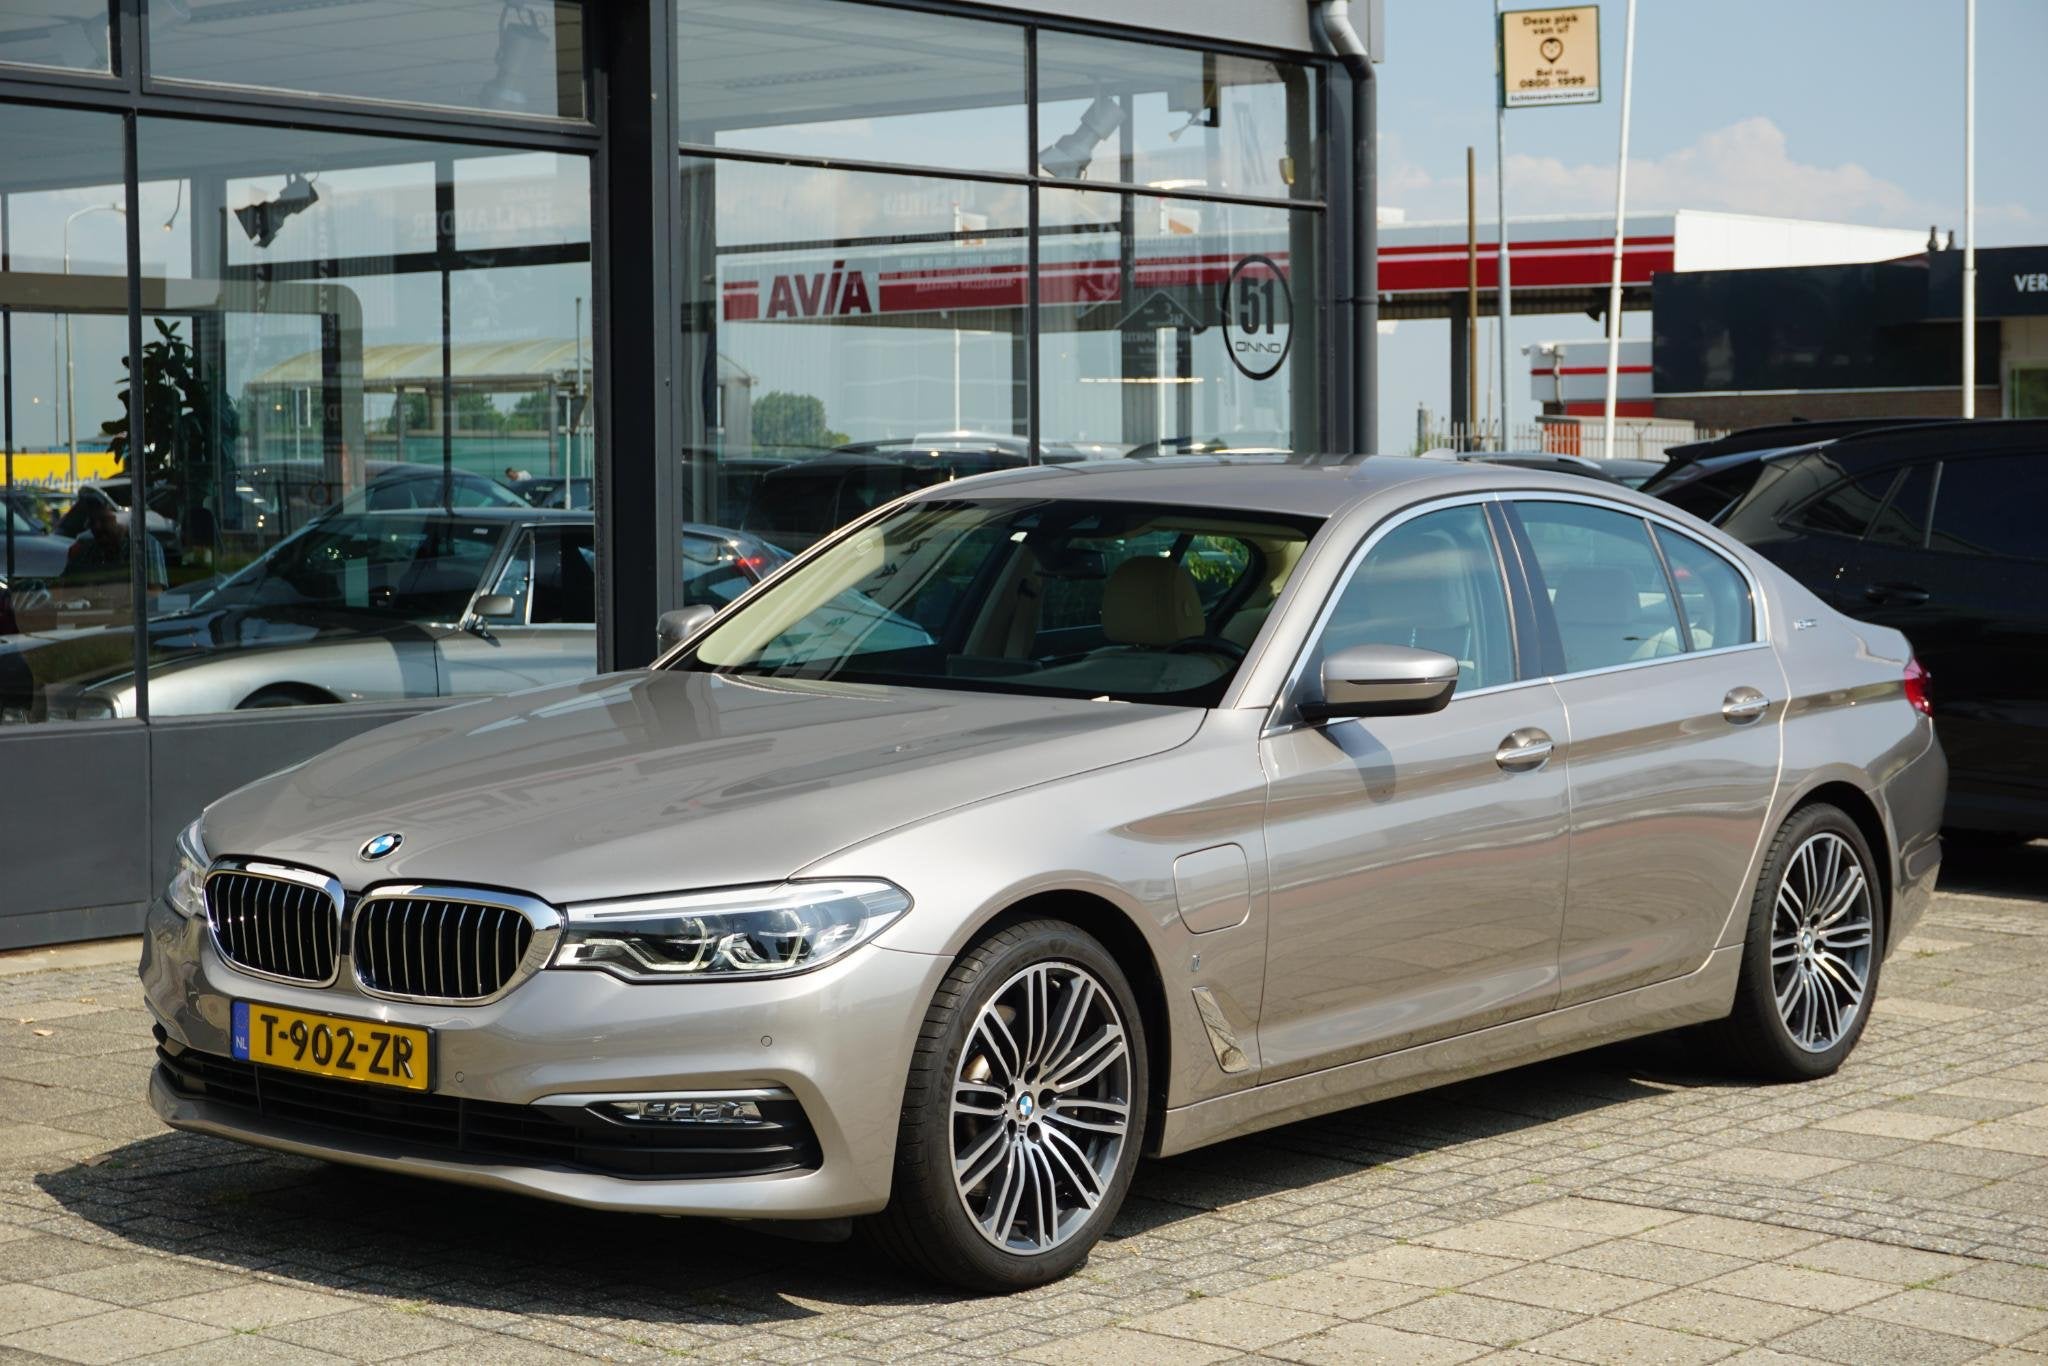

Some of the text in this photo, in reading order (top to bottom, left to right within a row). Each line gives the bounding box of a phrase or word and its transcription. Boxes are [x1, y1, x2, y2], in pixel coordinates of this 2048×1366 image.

[1522, 13, 1578, 26] Deze plek
[1533, 27, 1554, 36] van
[1536, 68, 1553, 77] Bel
[1240, 277, 1275, 335] 51
[1235, 341, 1281, 354] ONNO
[235, 1037, 248, 1051] NL
[260, 1014, 415, 1080] T-902-ZR
